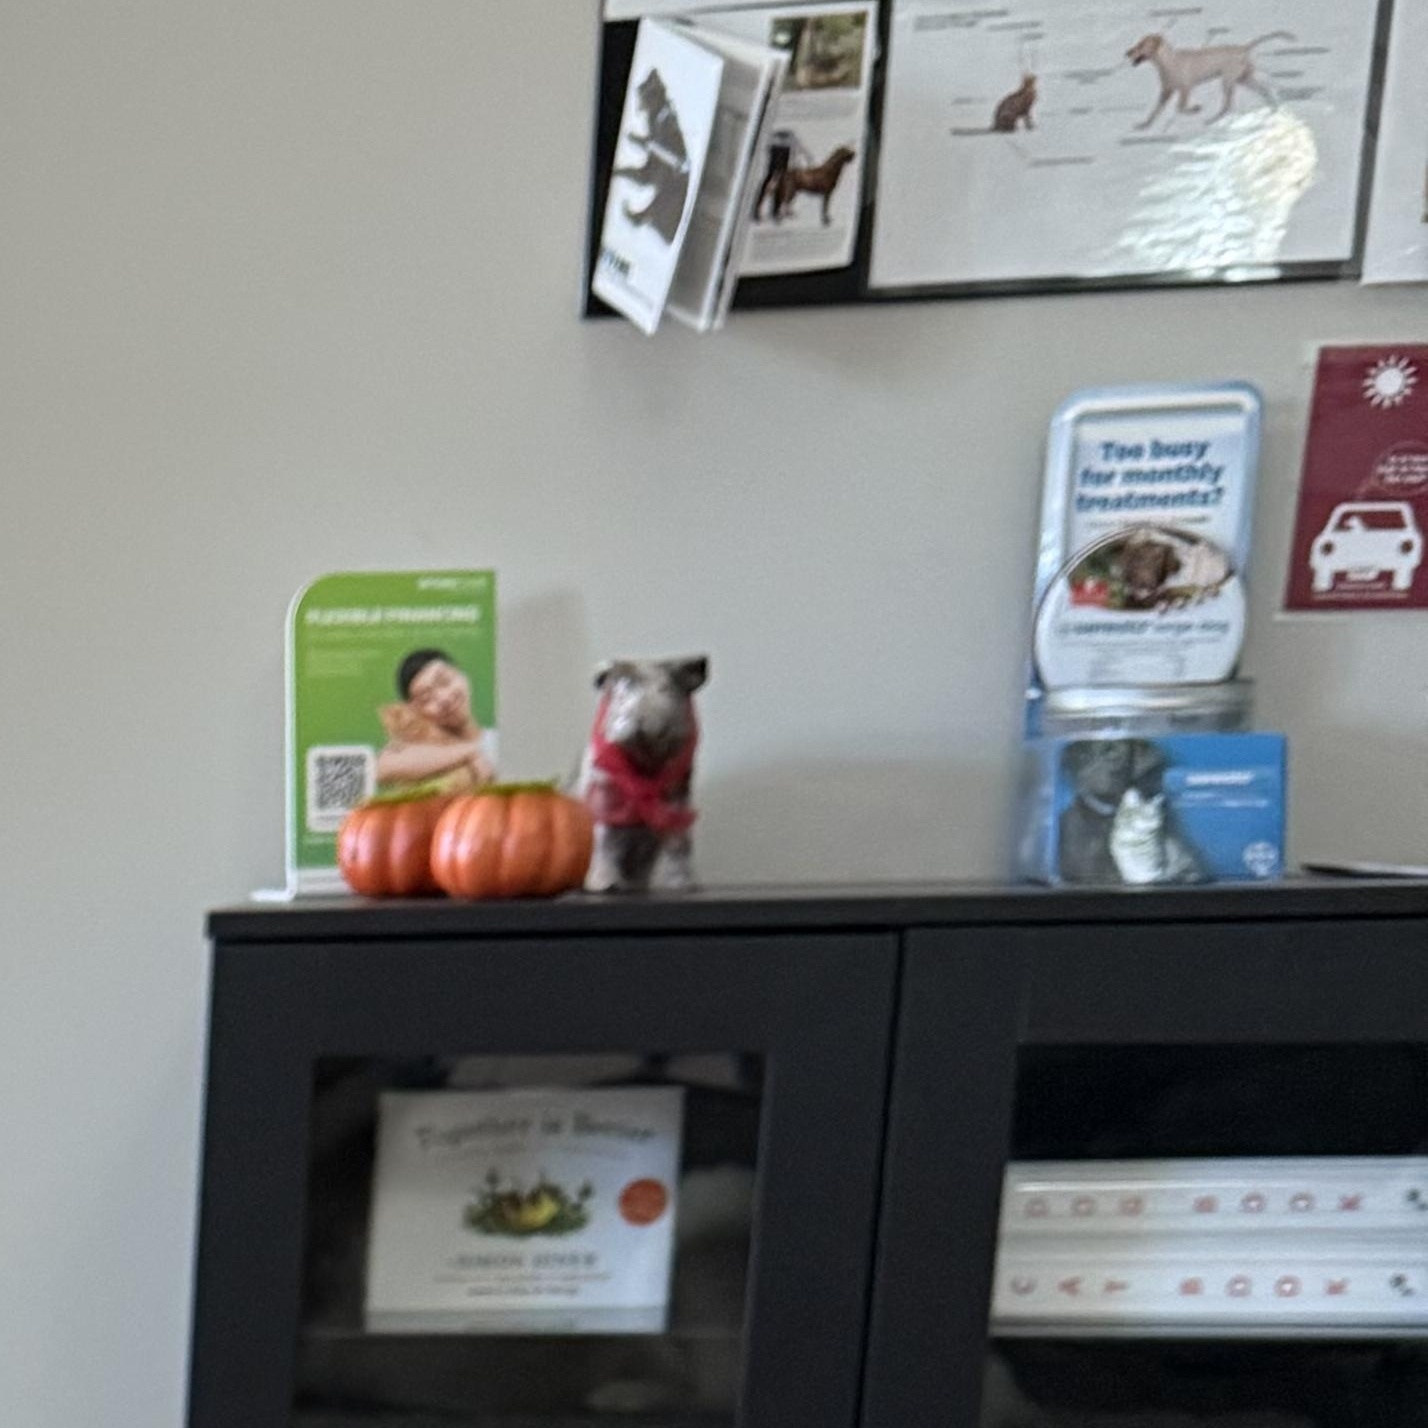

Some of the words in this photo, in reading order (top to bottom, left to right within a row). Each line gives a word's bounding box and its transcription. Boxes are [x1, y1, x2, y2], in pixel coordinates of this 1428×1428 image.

[1101, 440, 1145, 461] Too
[1150, 437, 1211, 463] busy
[1080, 467, 1116, 486] for
[1121, 462, 1225, 486] monthly
[1076, 487, 1225, 513] treatments?
